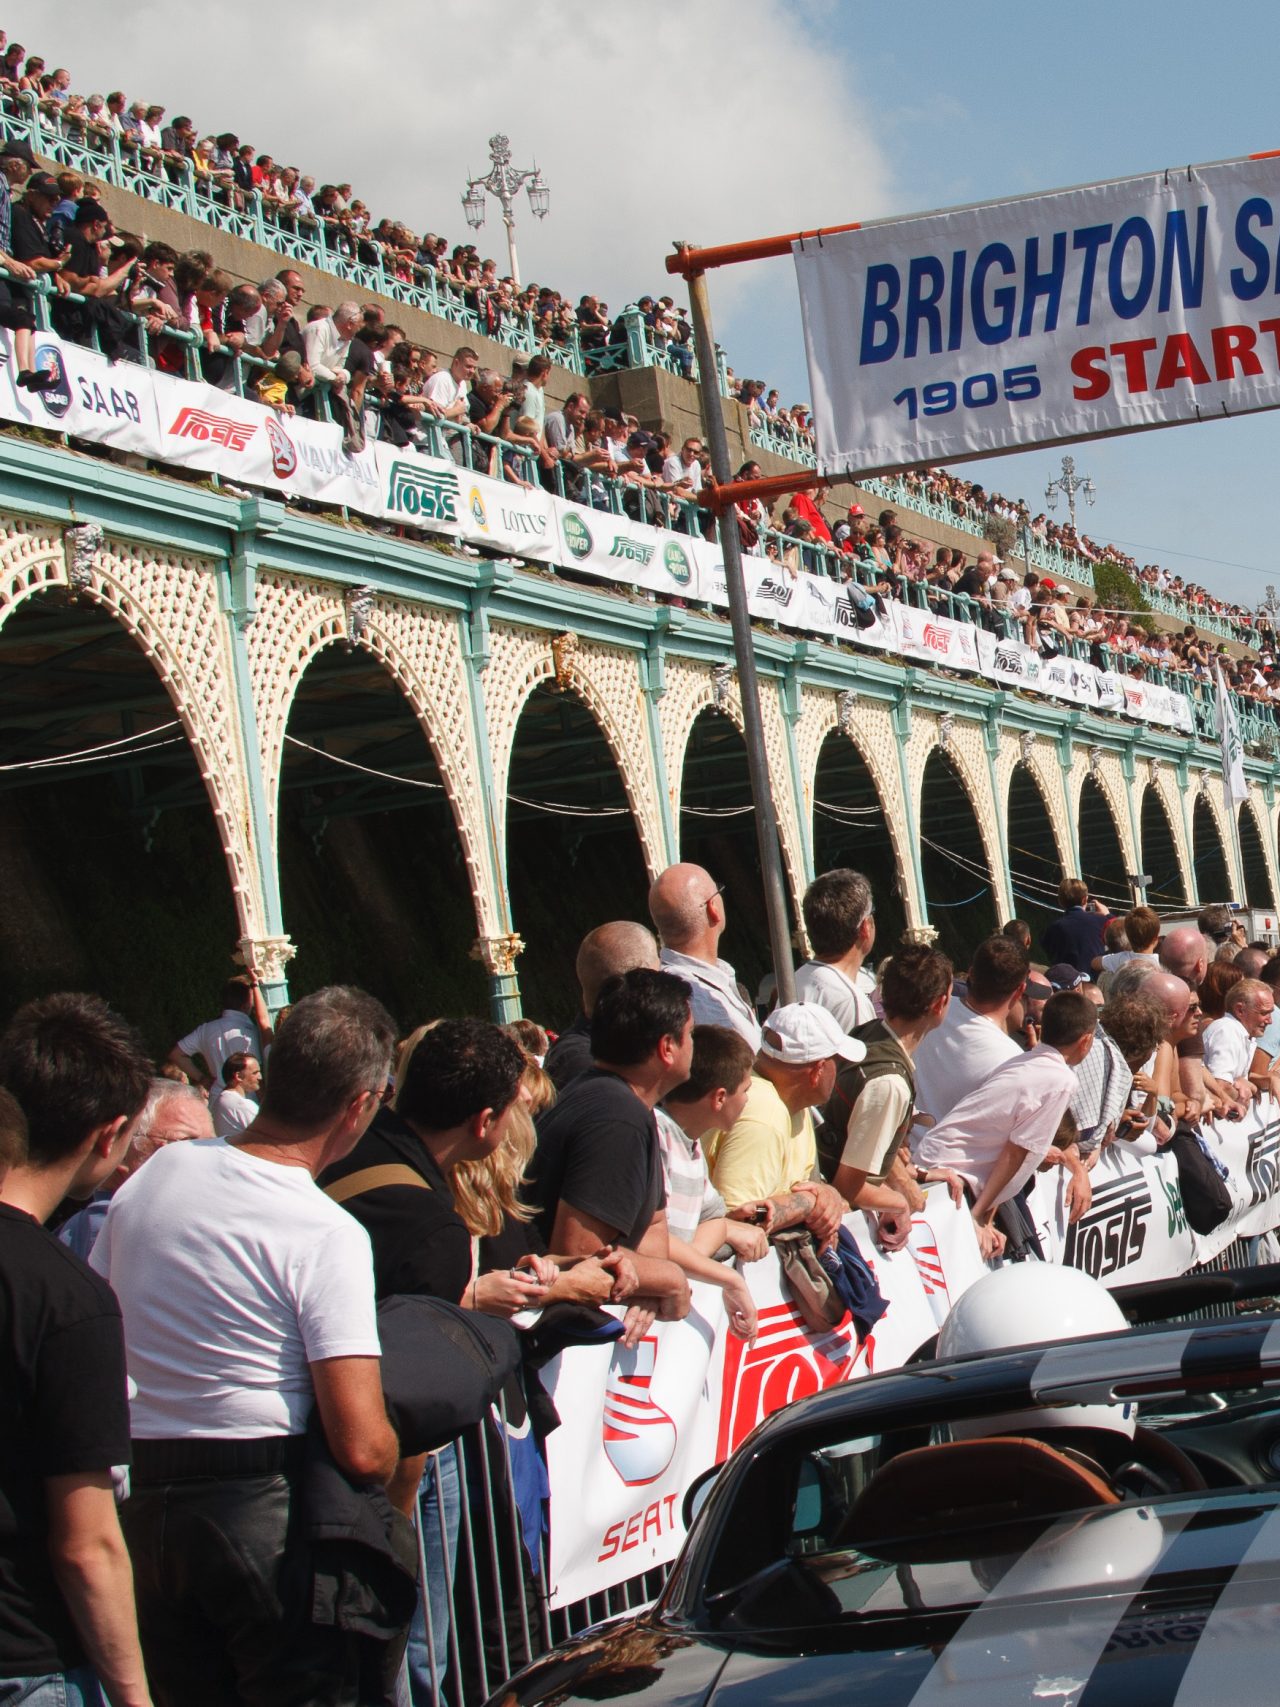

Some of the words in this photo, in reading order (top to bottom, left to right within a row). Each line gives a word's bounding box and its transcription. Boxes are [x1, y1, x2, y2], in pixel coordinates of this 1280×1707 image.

[859, 205, 1208, 366] BRIGHTON
[78, 376, 141, 423] SAAB
[893, 365, 1041, 421] 1905
[501, 508, 548, 536] LOTUS
[597, 1493, 679, 1563] SEAT
